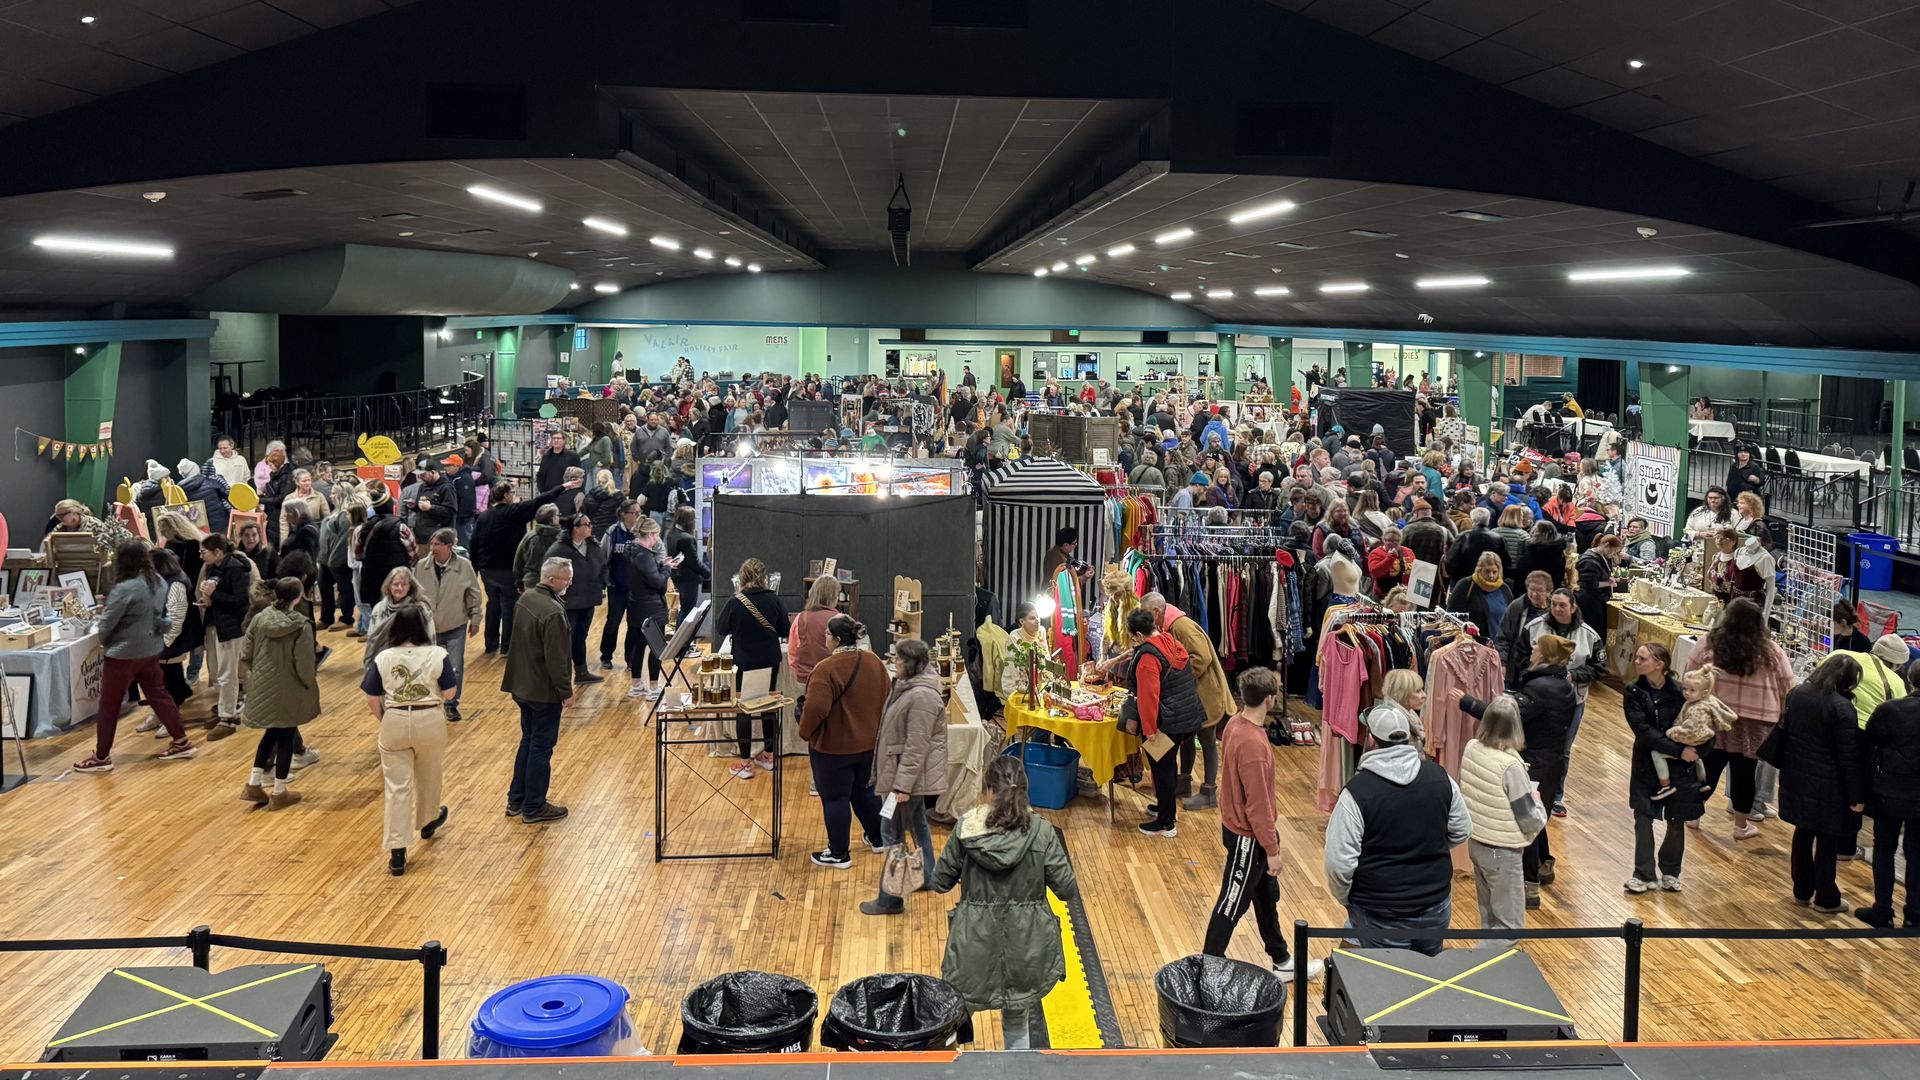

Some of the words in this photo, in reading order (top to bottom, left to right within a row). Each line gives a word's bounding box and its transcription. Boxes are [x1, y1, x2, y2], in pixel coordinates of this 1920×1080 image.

[1393, 351, 1419, 360] LDIES
[1639, 464, 1670, 482] small
[1638, 504, 1669, 520] studios
